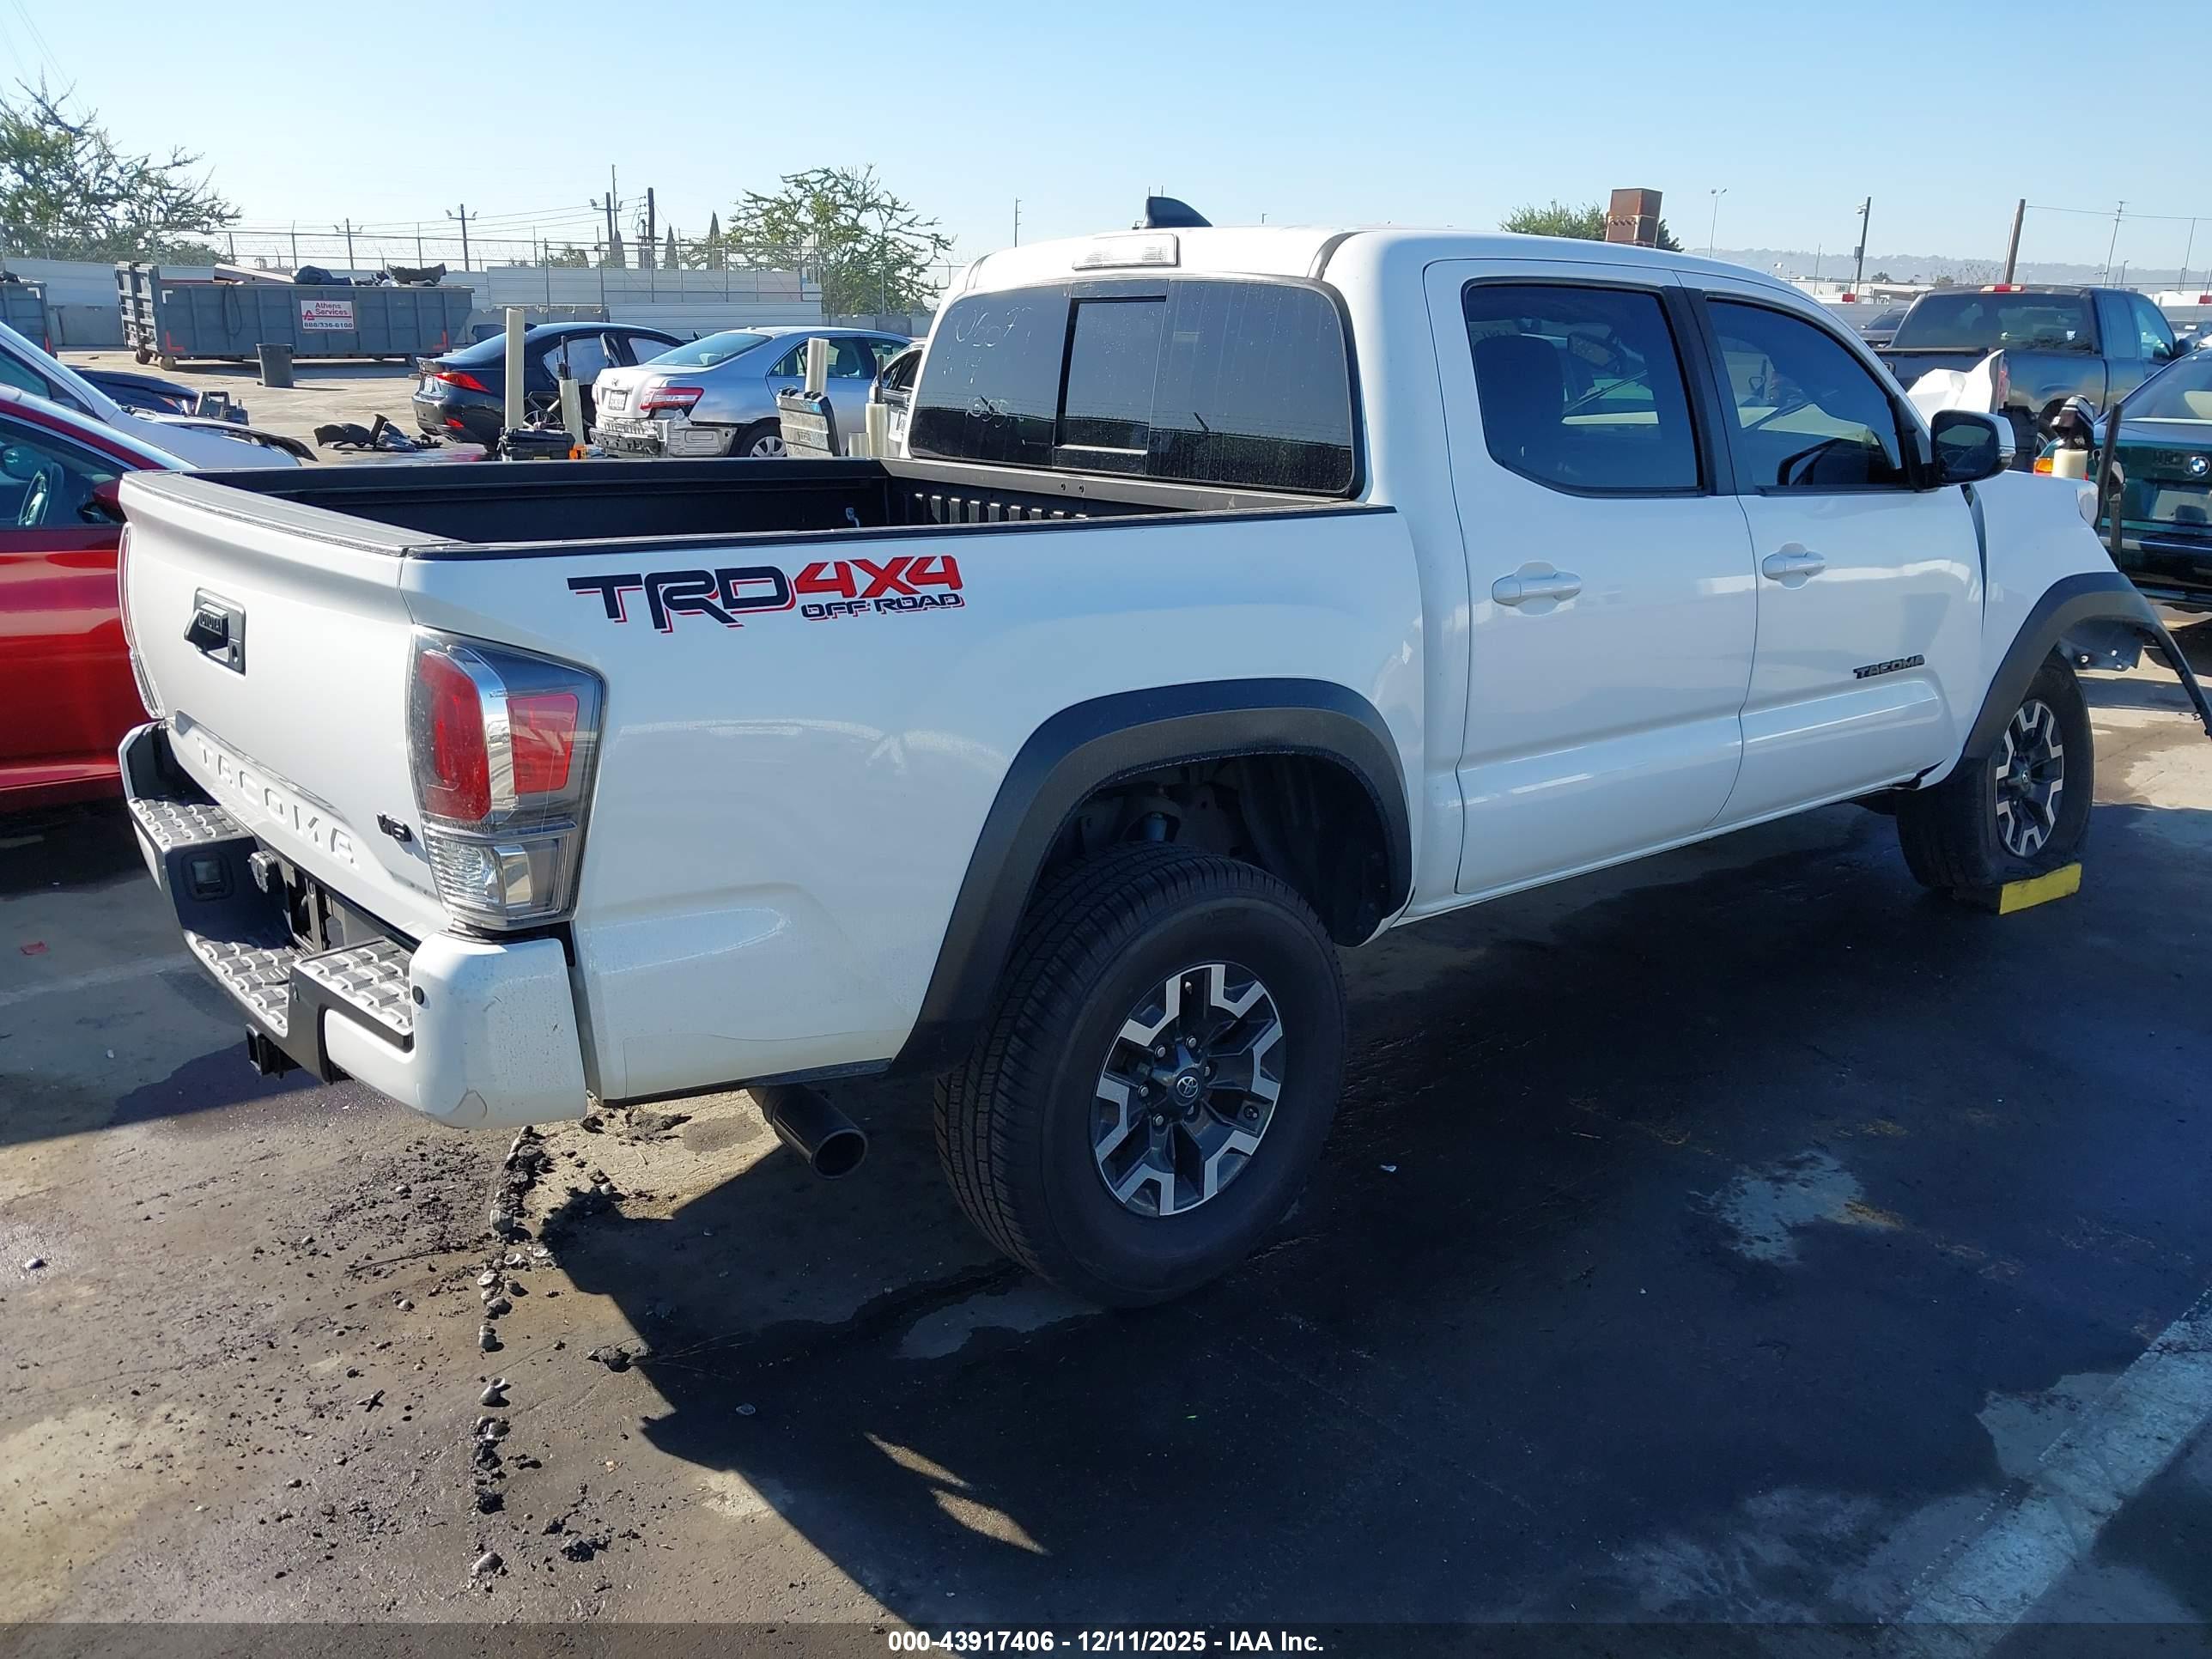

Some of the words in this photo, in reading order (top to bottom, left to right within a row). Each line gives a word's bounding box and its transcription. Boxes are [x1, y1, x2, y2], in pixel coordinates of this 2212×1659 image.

[567, 565, 797, 633] TRD
[800, 599, 871, 622] OFF
[874, 592, 965, 615] ROAD
[1853, 653, 1925, 679] TACOMA
[197, 736, 360, 870] TACOMA
[376, 812, 412, 842] V6
